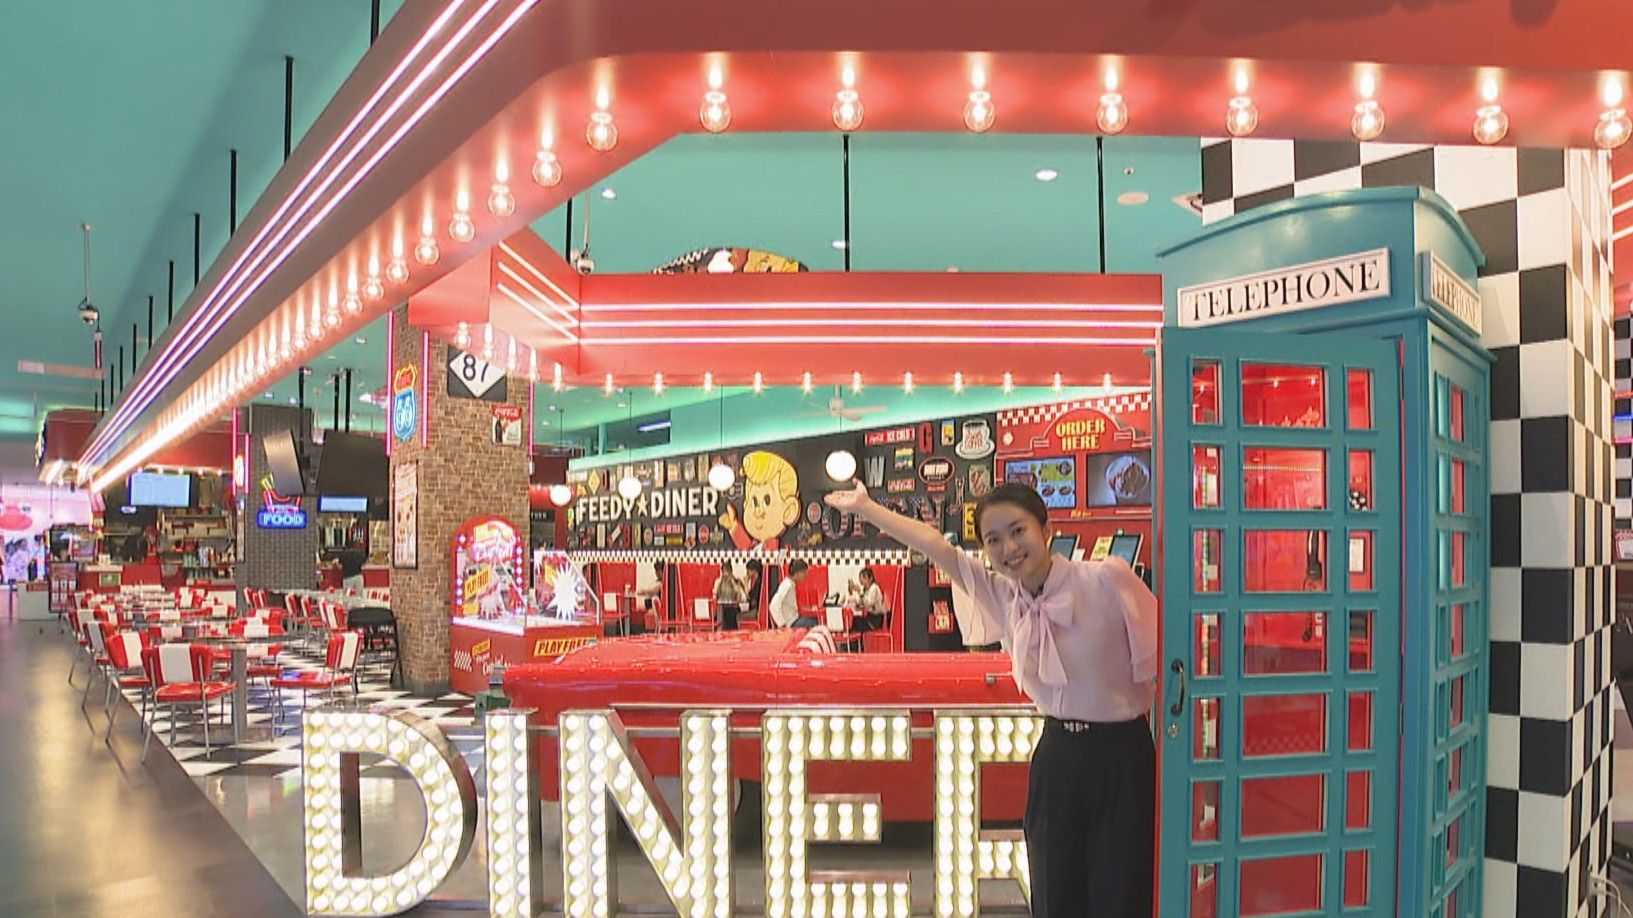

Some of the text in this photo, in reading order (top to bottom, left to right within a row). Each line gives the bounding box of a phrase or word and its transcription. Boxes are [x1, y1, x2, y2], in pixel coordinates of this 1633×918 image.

[1187, 260, 1380, 321] TELEPHONE
[1056, 418, 1105, 437] ORDER
[1062, 434, 1099, 451] HERE
[579, 486, 718, 522] FEEDY DINER
[263, 511, 304, 526] FOOD
[302, 708, 1043, 918] DINER
